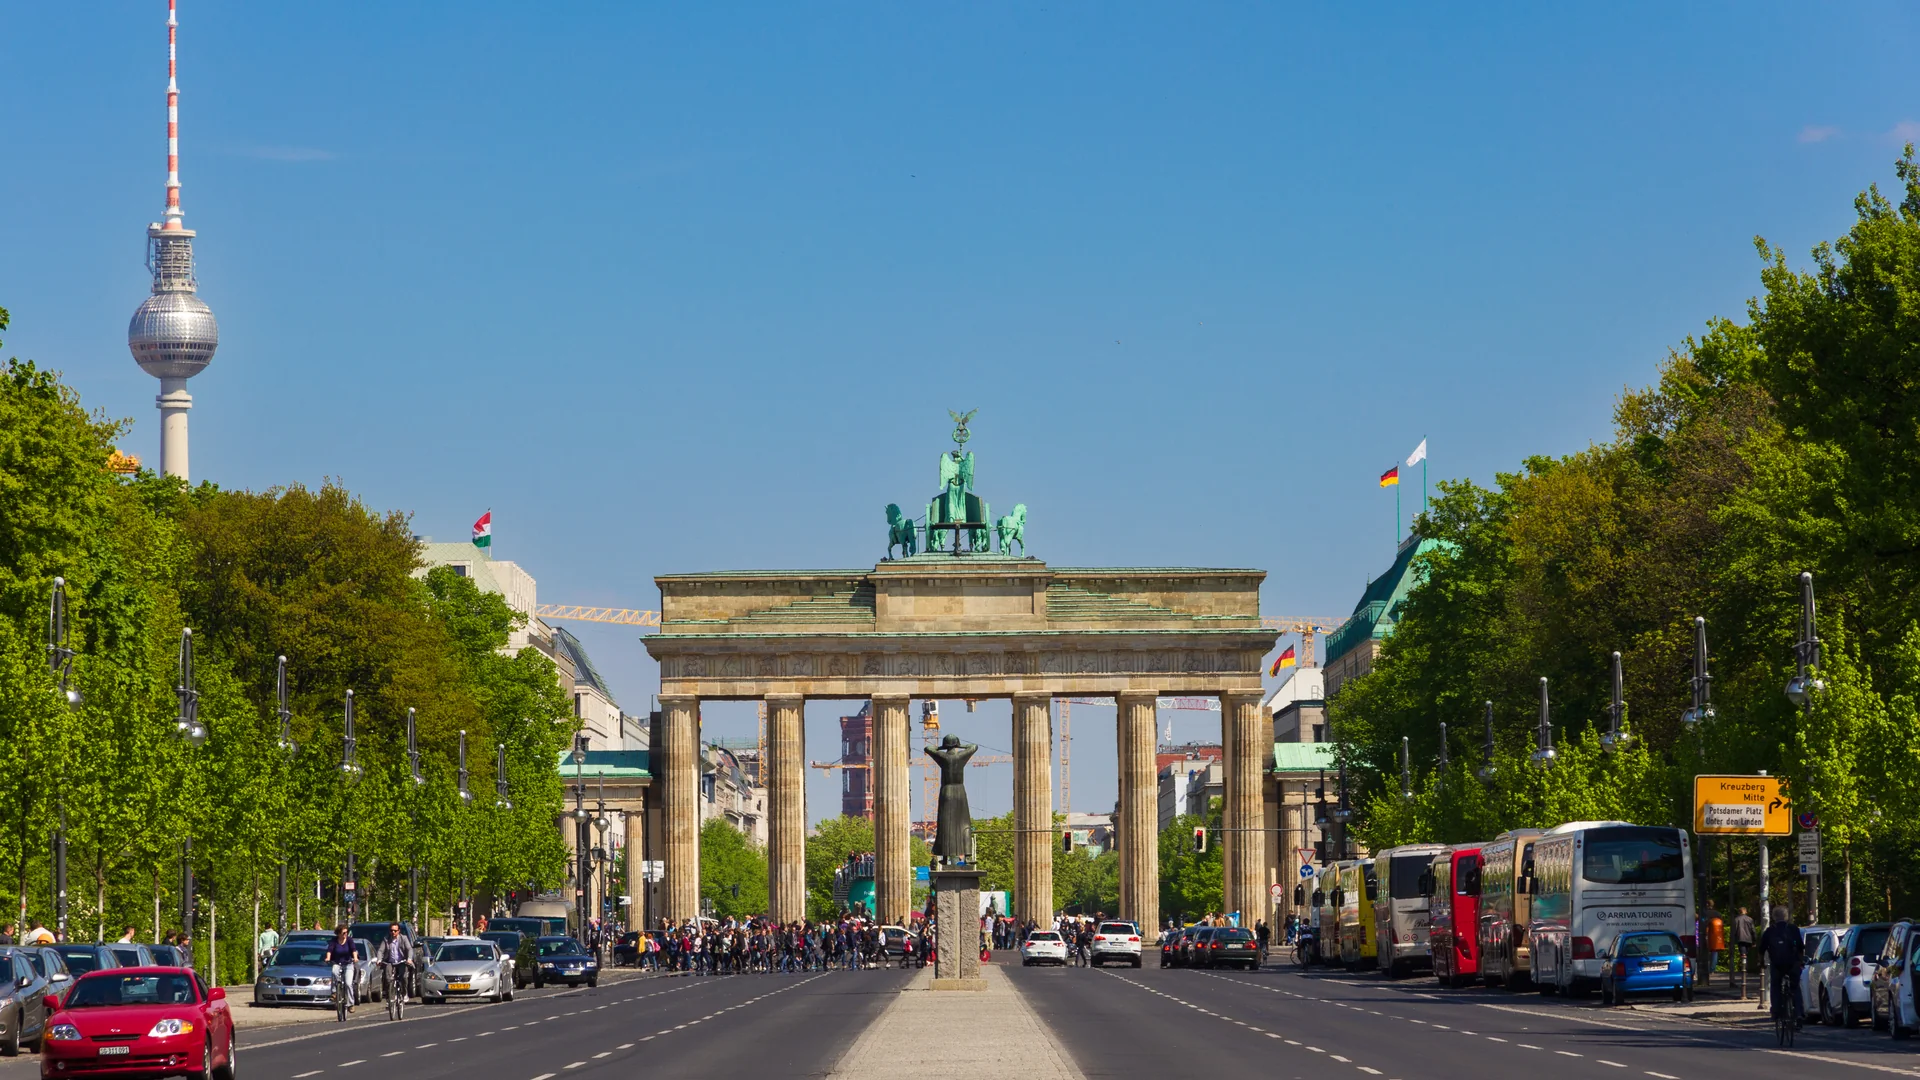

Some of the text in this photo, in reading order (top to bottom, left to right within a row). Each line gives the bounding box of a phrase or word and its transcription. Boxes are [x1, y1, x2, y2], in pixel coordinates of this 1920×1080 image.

[1720, 782, 1765, 792] Kreuzberg
[1743, 793, 1765, 801] Mitte
[1709, 806, 1762, 815] Potsdamer Platz
[1705, 818, 1762, 826] Unter den Linden
[1607, 911, 1673, 919] ARRIVA TOURING
